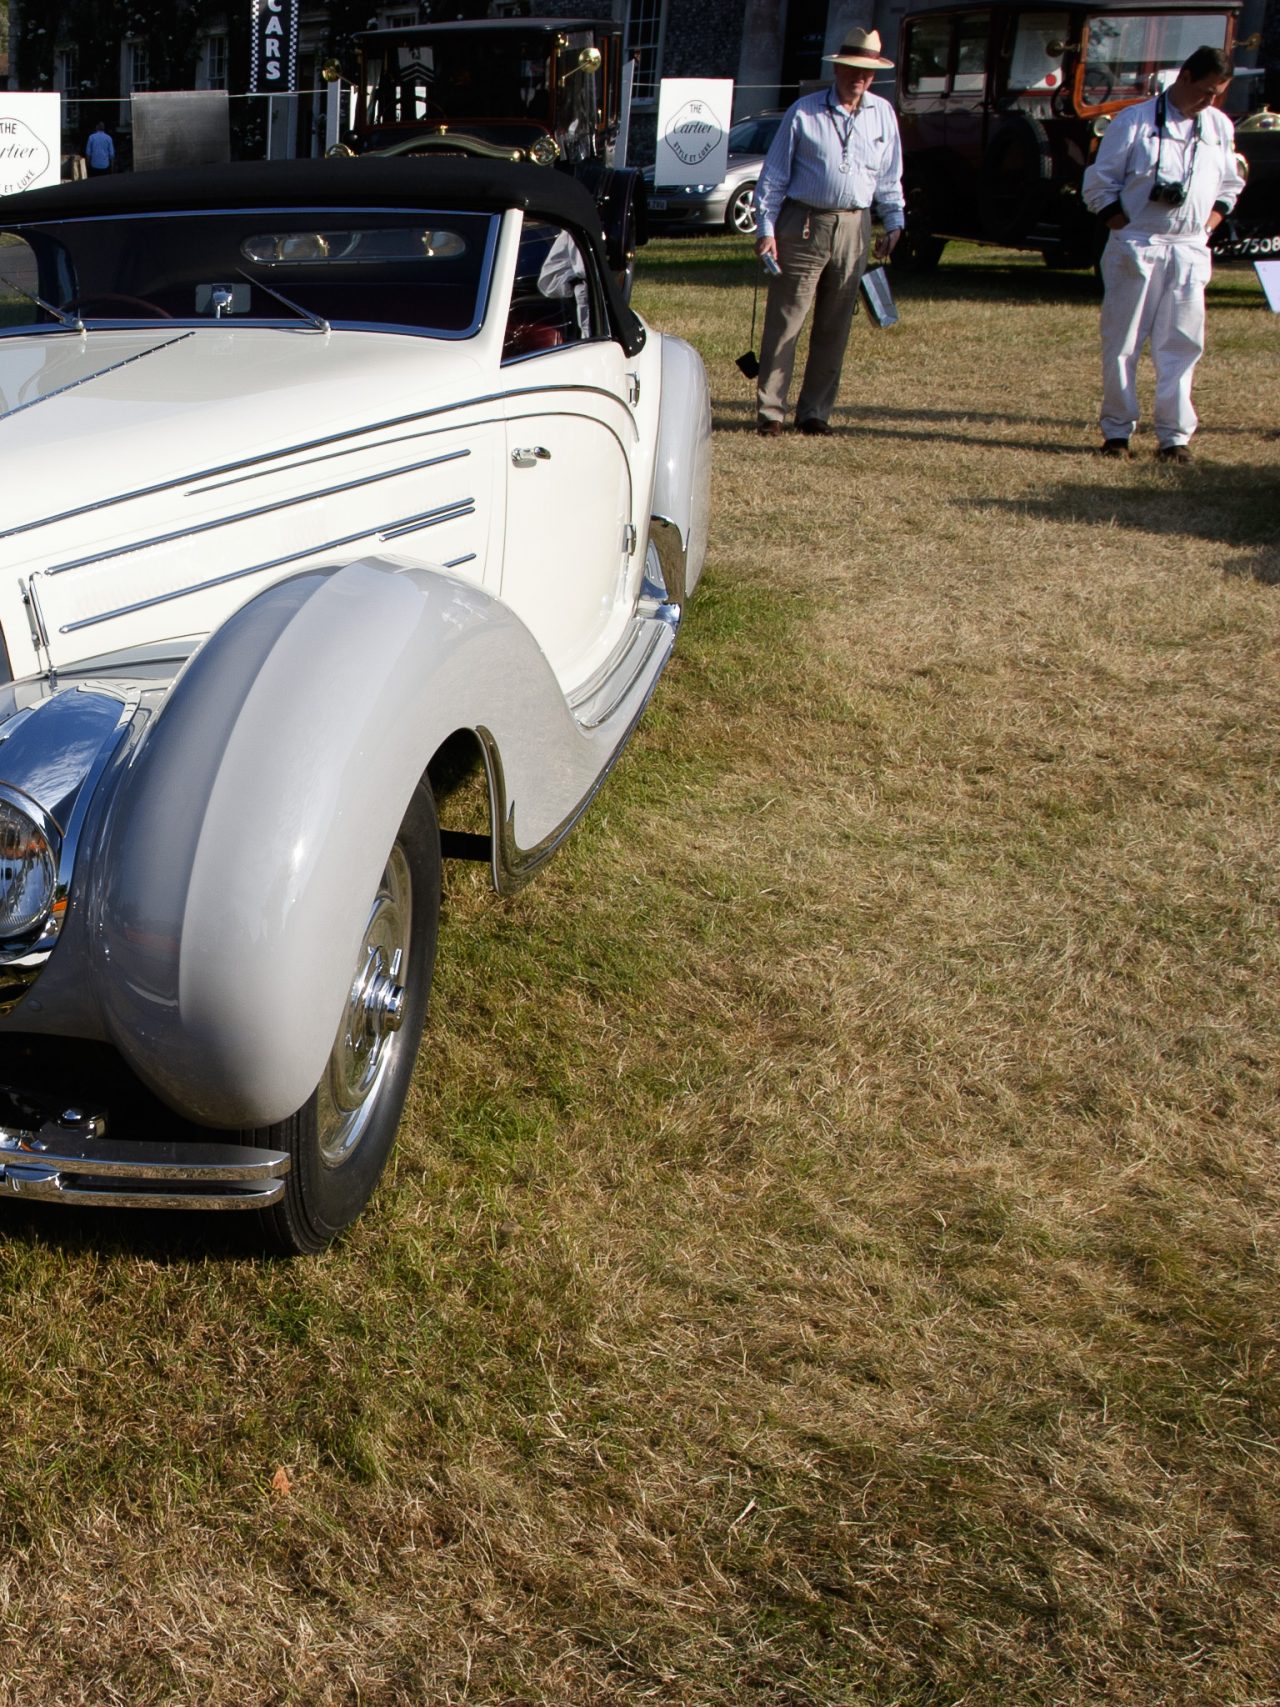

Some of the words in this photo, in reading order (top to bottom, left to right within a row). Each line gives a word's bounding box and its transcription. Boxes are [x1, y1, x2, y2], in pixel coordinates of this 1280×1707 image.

[265, 0, 283, 80] CARS
[690, 104, 701, 114] THE
[0, 123, 17, 135] THE
[673, 116, 713, 134] Cartier
[673, 142, 688, 161] STYLE
[5, 185, 13, 193] ET
[17, 169, 35, 190] LUXE
